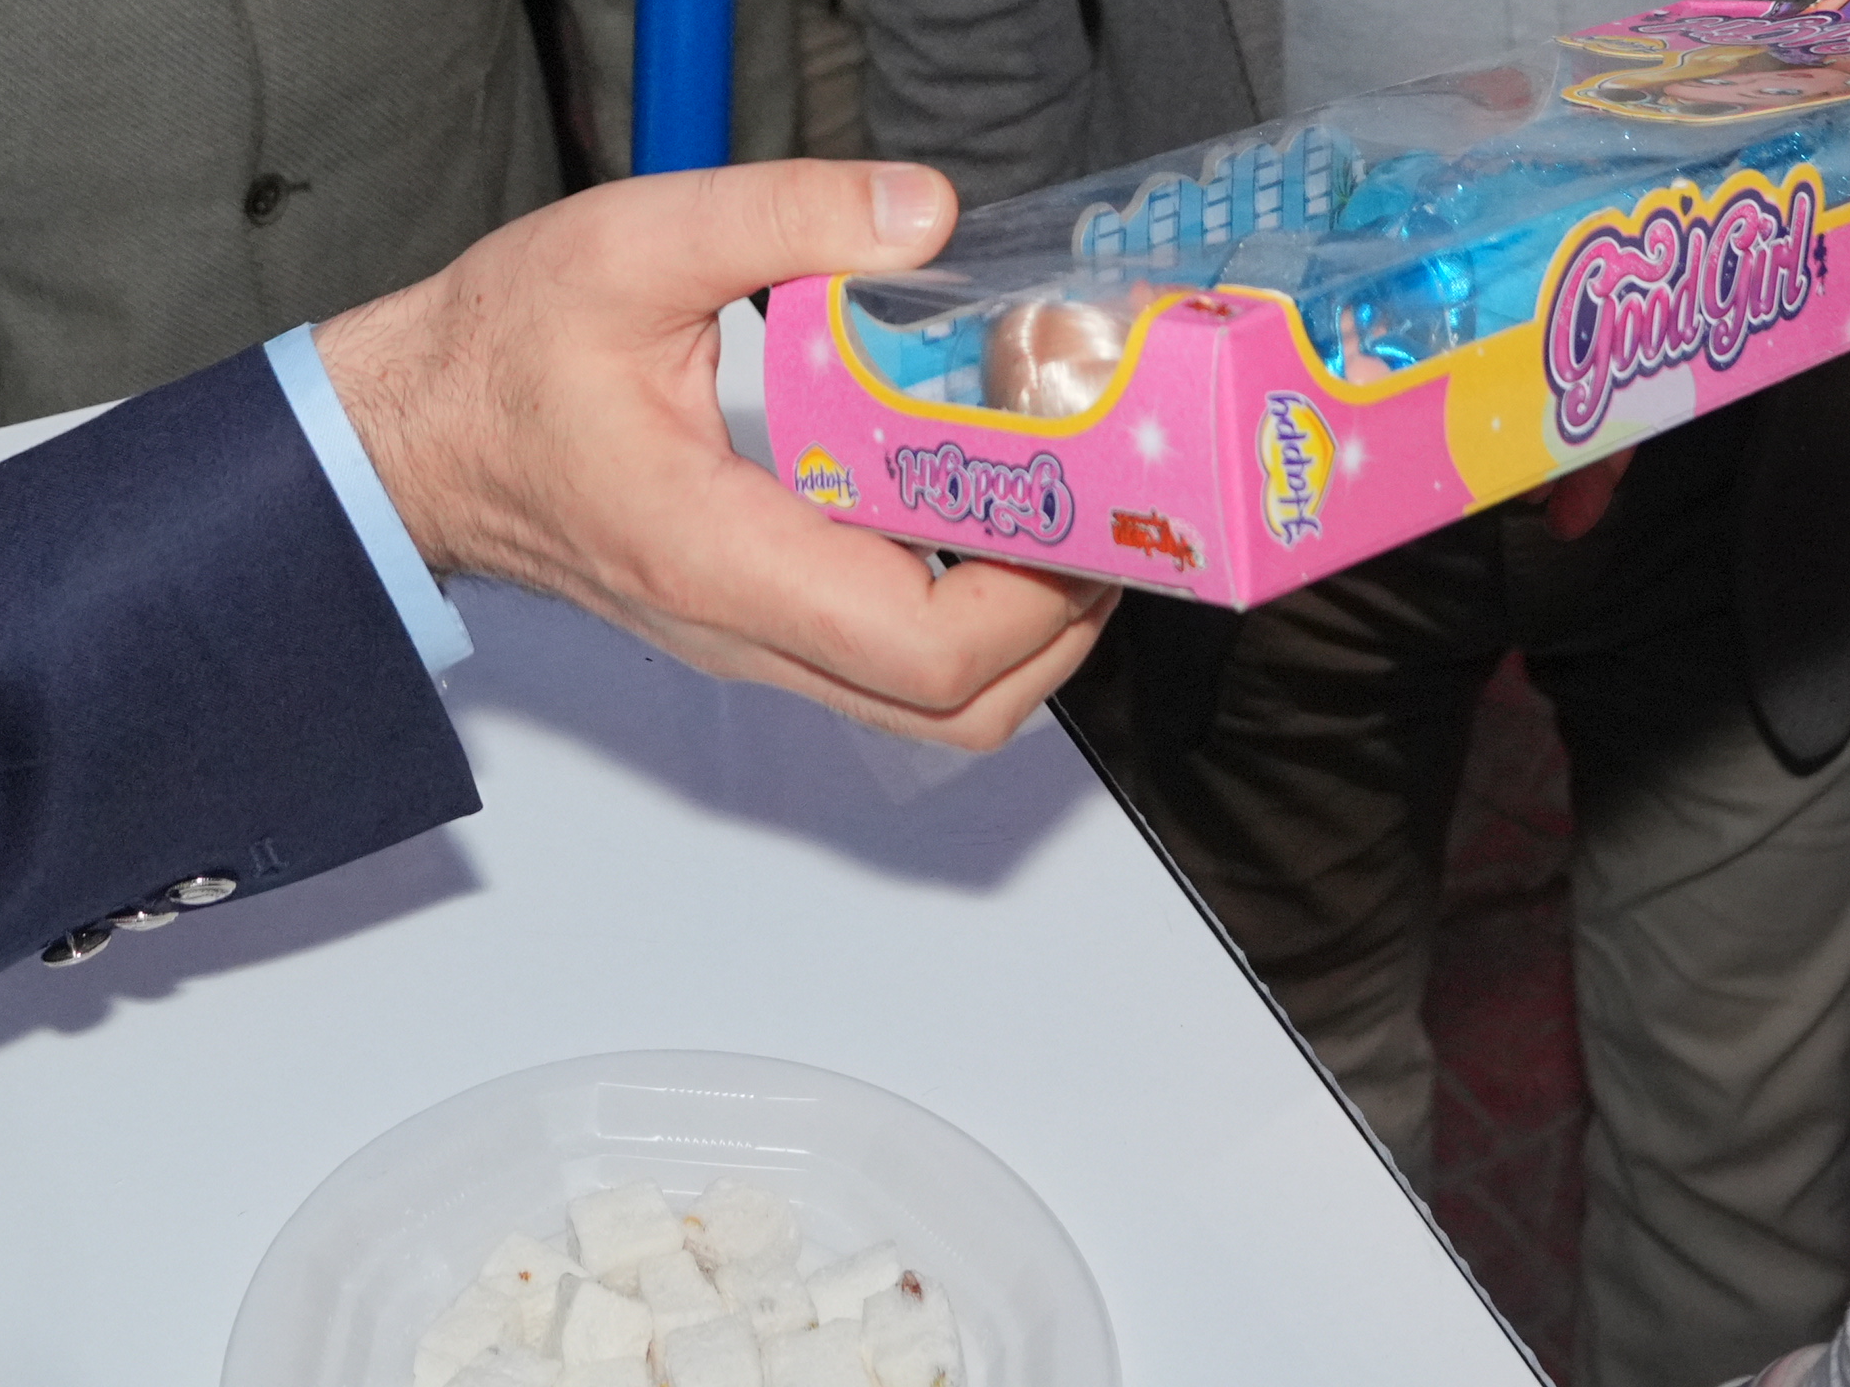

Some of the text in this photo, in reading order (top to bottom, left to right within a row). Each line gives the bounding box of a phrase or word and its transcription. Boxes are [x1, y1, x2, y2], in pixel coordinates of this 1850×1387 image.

[1546, 189, 1812, 437] Good Girl
[794, 464, 856, 504] Happy
[897, 442, 1075, 544] Good Girl
[1266, 393, 1320, 546] Happy
